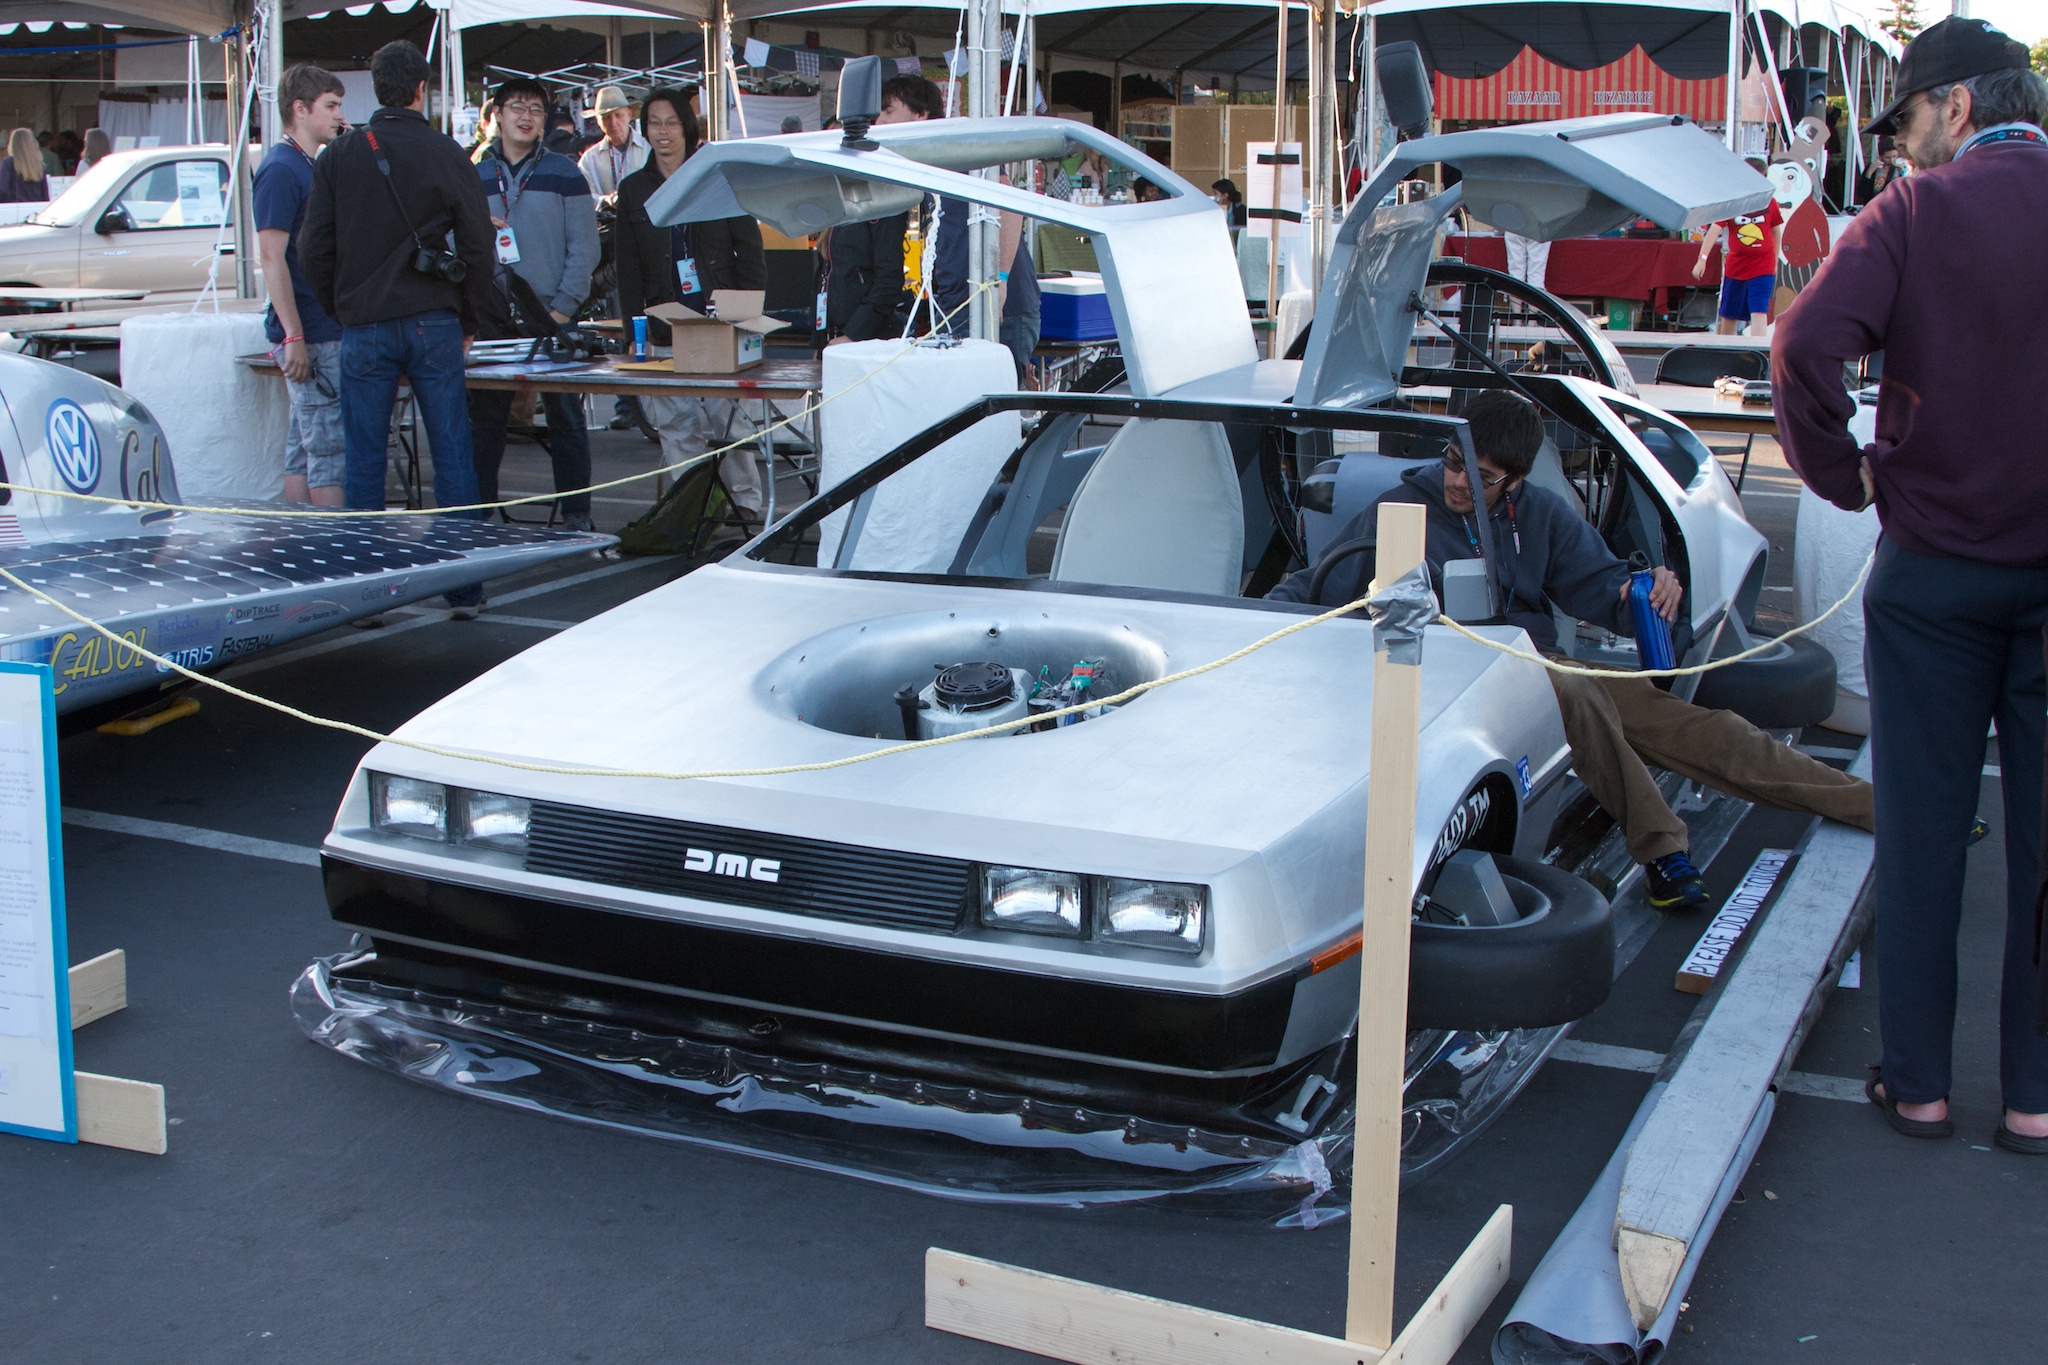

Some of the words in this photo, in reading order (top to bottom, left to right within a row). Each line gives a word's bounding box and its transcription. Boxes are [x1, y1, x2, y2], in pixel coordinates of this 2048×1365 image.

[1507, 91, 1561, 105] BAZAAR
[1594, 91, 1653, 105] BIZARRE
[119, 429, 175, 528] Cal
[51, 627, 148, 696] CALSOL
[1725, 892, 1764, 915] NOT
[1712, 914, 1749, 932] DO
[1687, 933, 1738, 977] PLEASE
